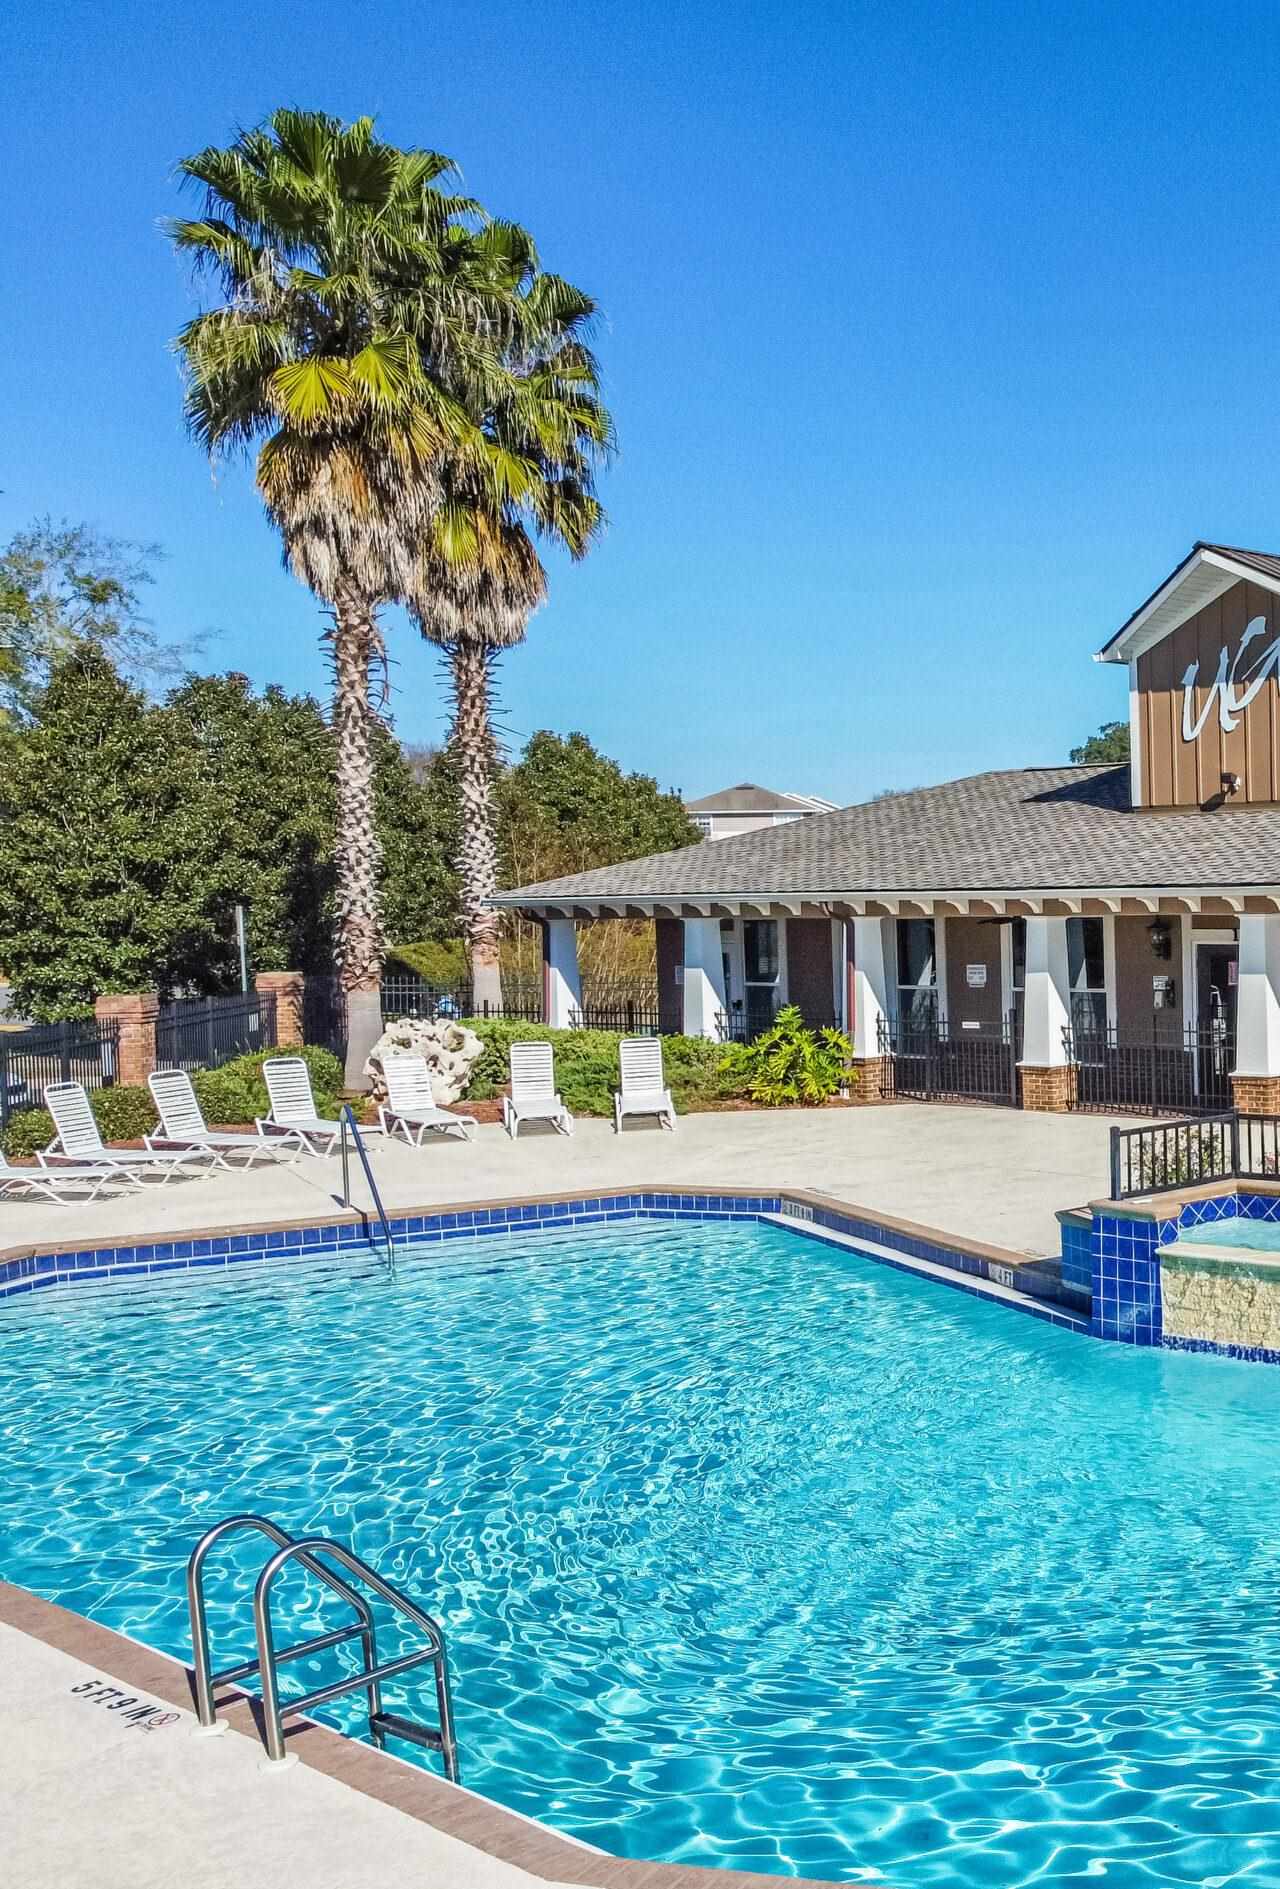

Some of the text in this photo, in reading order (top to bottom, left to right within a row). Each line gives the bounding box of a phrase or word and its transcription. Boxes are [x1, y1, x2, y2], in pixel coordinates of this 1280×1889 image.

[71, 1680, 103, 1693] 5
[106, 1697, 139, 1710] 9
[120, 1704, 163, 1721] IN
